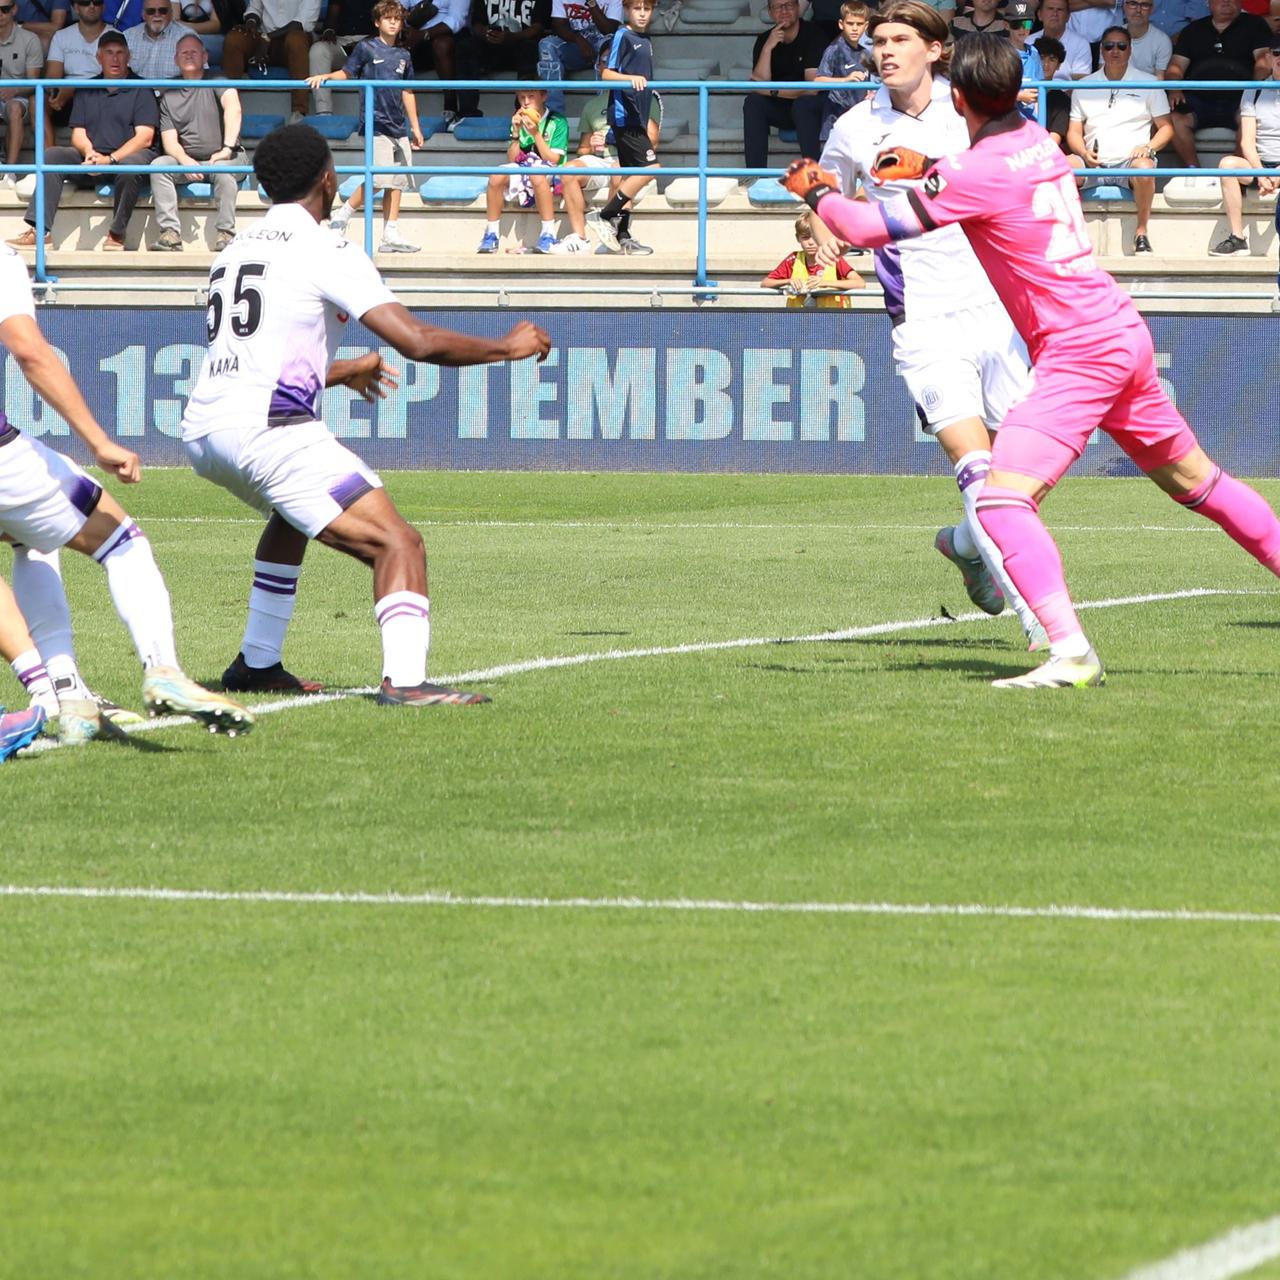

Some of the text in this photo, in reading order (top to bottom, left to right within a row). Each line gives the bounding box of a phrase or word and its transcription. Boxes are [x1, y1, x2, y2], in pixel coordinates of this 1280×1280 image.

[210, 263, 267, 341] 55
[209, 356, 239, 379] KANA
[324, 346, 865, 441] EPTEMBER
